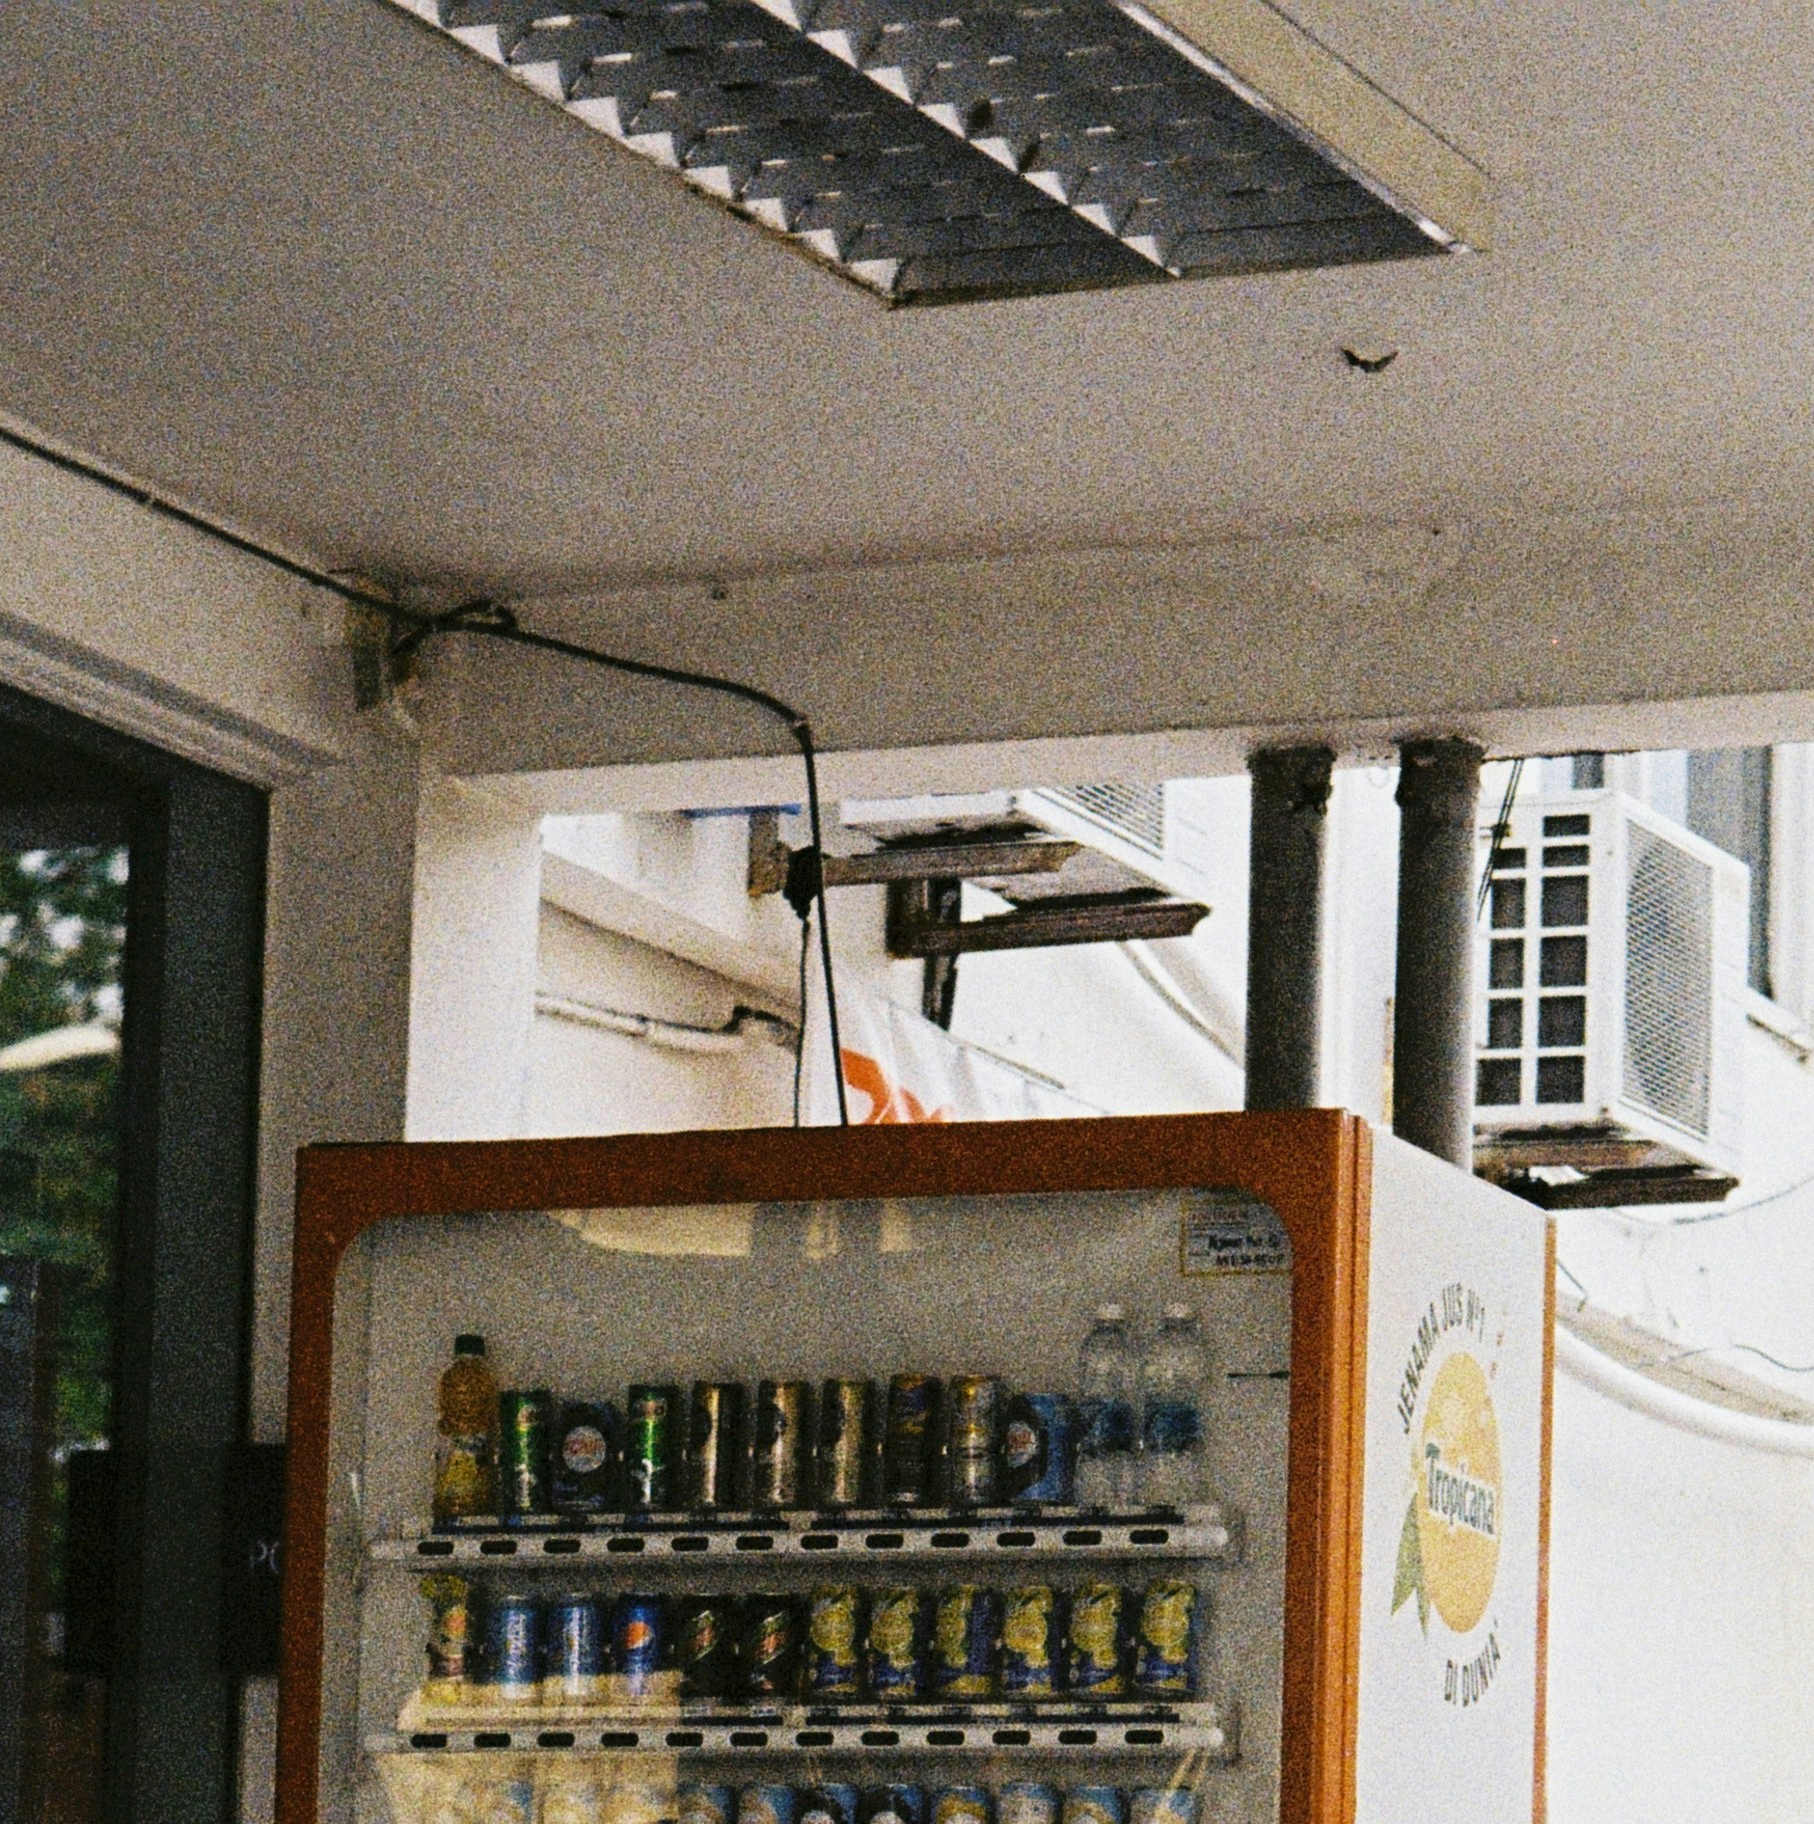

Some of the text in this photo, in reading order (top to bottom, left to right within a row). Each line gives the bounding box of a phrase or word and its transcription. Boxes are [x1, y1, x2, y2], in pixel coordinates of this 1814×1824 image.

[1397, 1301, 1441, 1436] JENAMA
[1442, 1281, 1464, 1332] JUS
[1425, 1441, 1495, 1537] Tropicana
[1444, 1632, 1501, 1708] DI DUNIA
